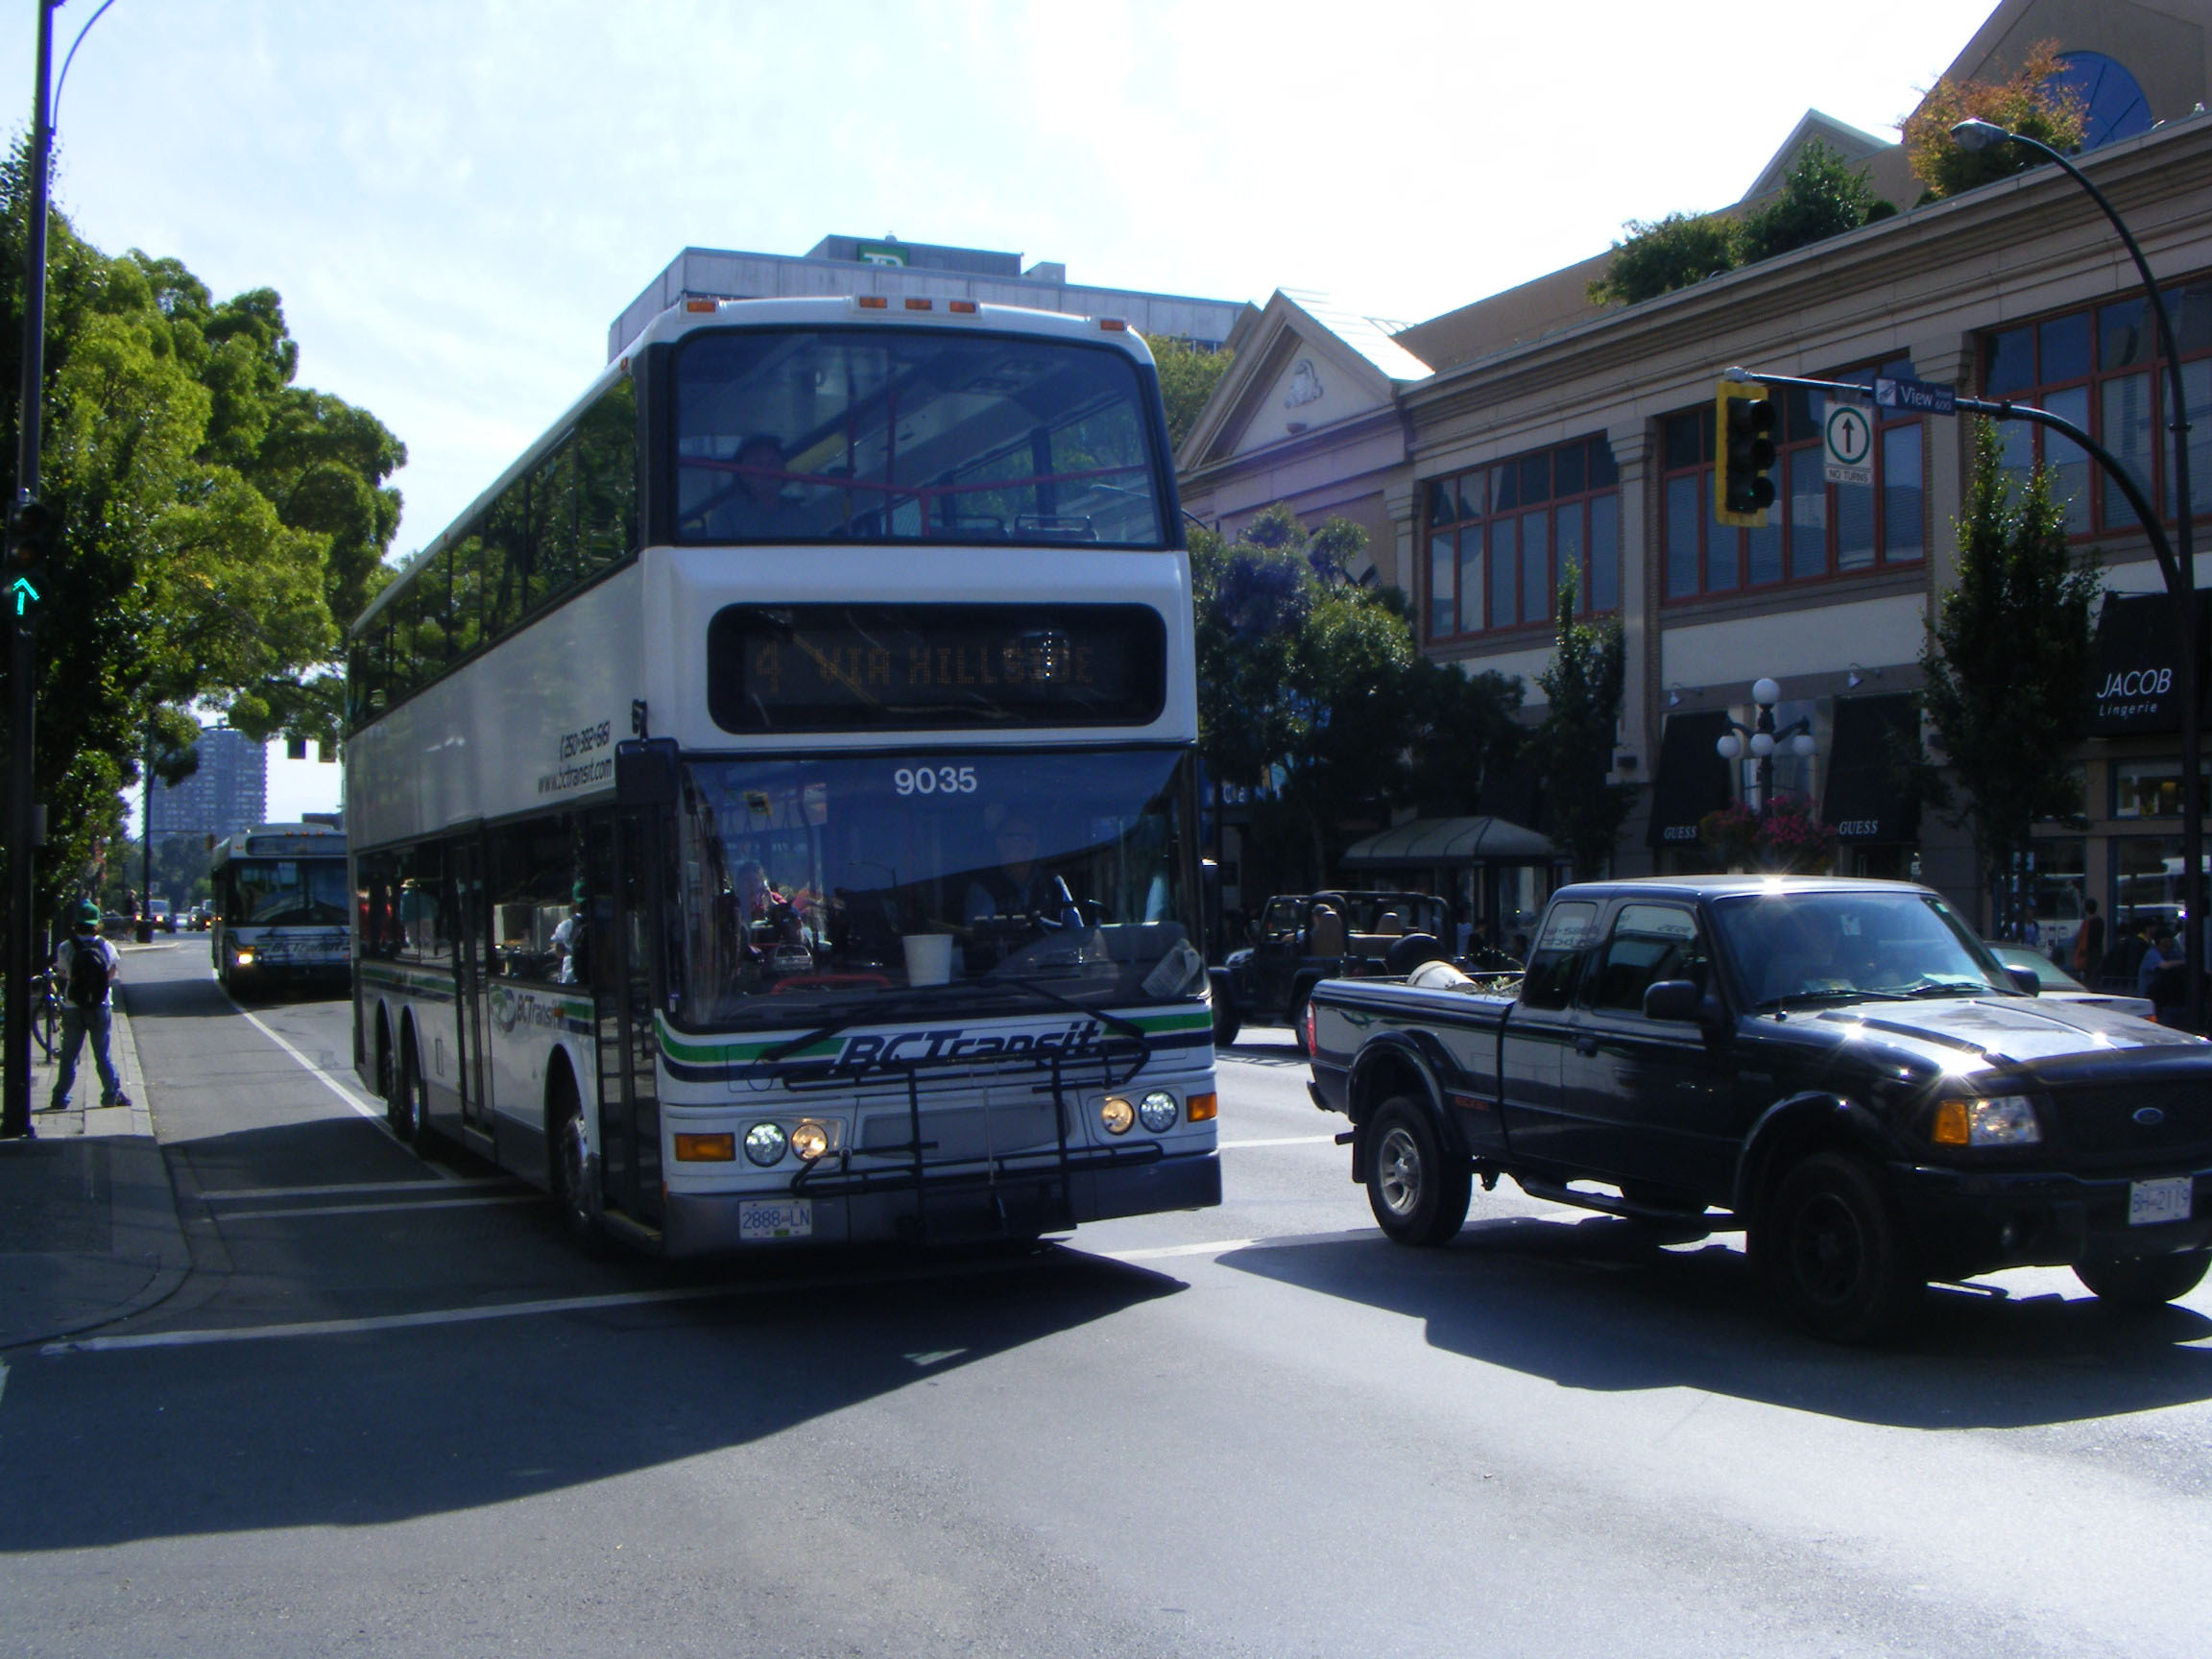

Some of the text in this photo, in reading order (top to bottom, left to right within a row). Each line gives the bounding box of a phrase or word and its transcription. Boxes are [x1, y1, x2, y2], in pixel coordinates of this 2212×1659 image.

[1900, 384, 1934, 407] View
[1934, 399, 1953, 411] 600
[1829, 469, 1868, 483] NO TURNS
[755, 641, 781, 693] 4
[818, 646, 892, 685] VIA
[2096, 667, 2173, 699] JACOB
[2099, 701, 2158, 721] Lingerie
[894, 766, 977, 796] 9035
[1663, 826, 1697, 840] GUESS
[1838, 819, 1879, 835] GUESS
